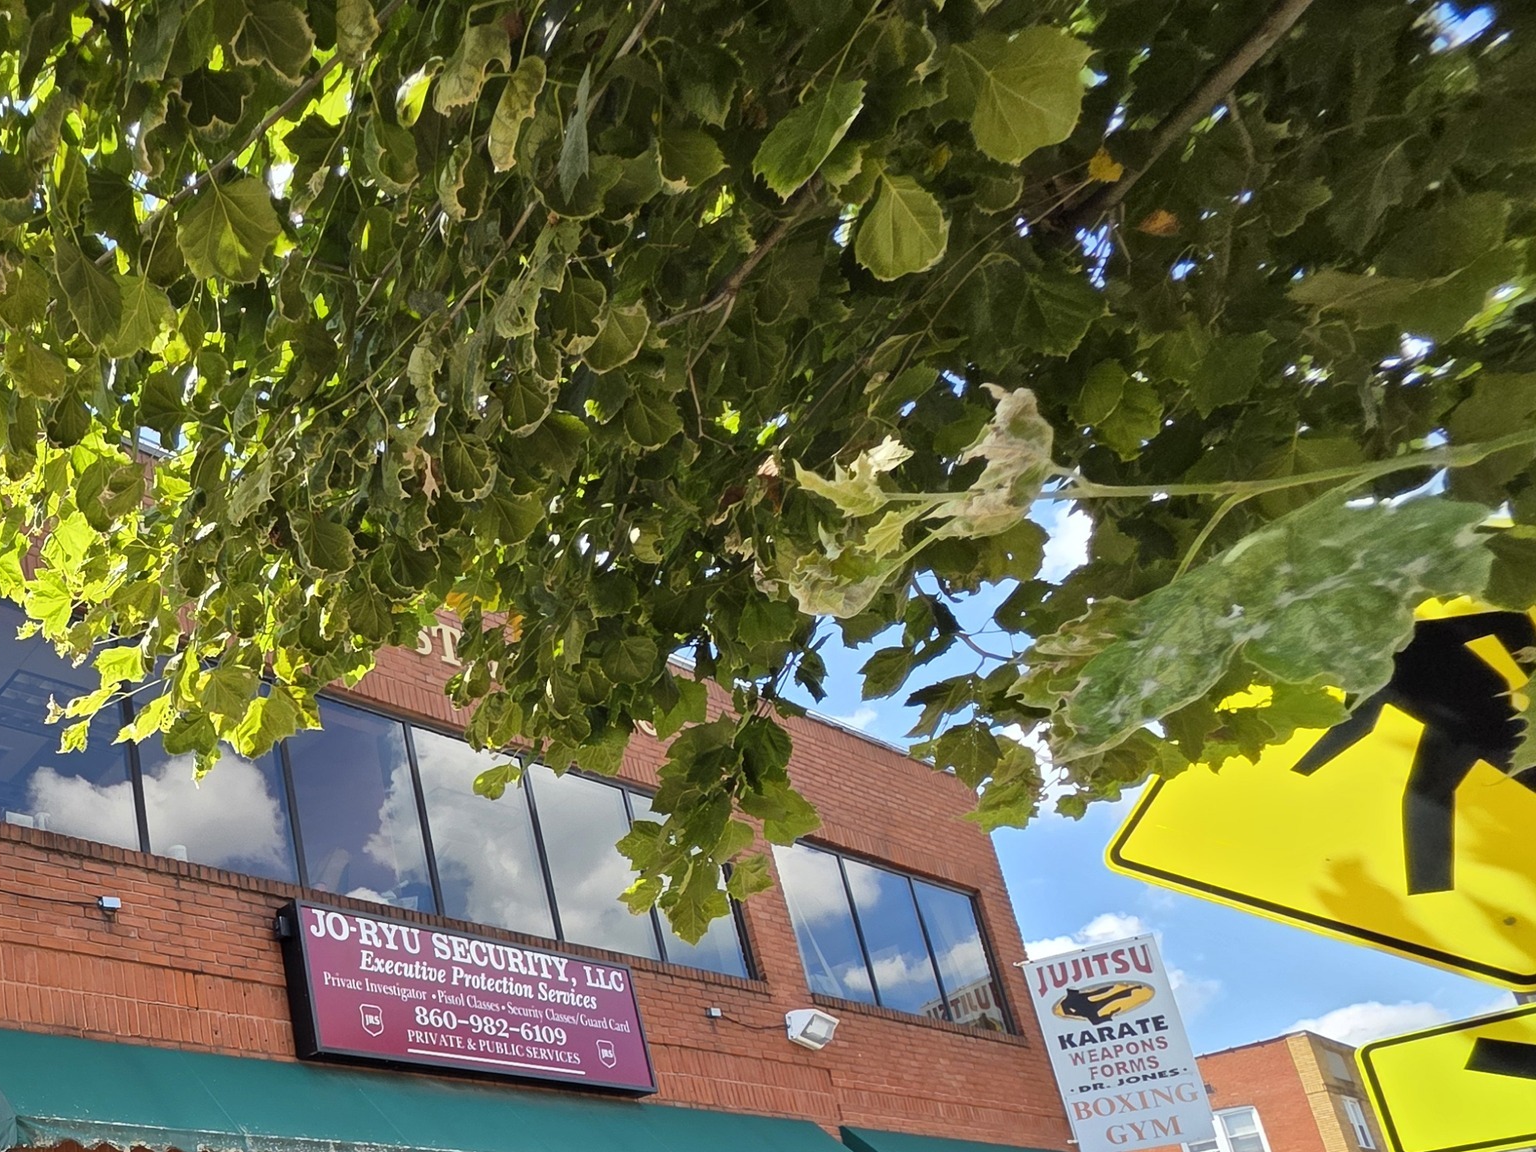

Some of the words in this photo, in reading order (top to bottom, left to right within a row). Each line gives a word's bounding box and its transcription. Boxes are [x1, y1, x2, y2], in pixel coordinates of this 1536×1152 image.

[310, 908, 420, 954] JO-RYU
[432, 932, 577, 987] SECURITY,
[584, 966, 625, 993] LLC
[359, 950, 447, 984] Executive
[451, 969, 533, 999] Protection
[538, 987, 597, 1009] Services
[1036, 944, 1154, 998] JUJITSU
[324, 972, 363, 991] Private
[365, 979, 427, 1001] Investigator
[466, 995, 500, 1012] Classes
[608, 1019, 630, 1034] Card
[364, 1014, 381, 1027] JRS
[415, 1007, 567, 1045] 860-982-6109
[1057, 1014, 1169, 1051] KARATE
[407, 1029, 464, 1049] PRIVATE
[467, 1038, 476, 1051] &
[479, 1039, 524, 1058] PUBLIC
[525, 1045, 581, 1065] SERVICES
[1068, 1035, 1169, 1066] WEAPONS
[1088, 1055, 1160, 1080] FORMS
[1071, 1082, 1199, 1121] BOXING
[1105, 1115, 1185, 1145] GYM
